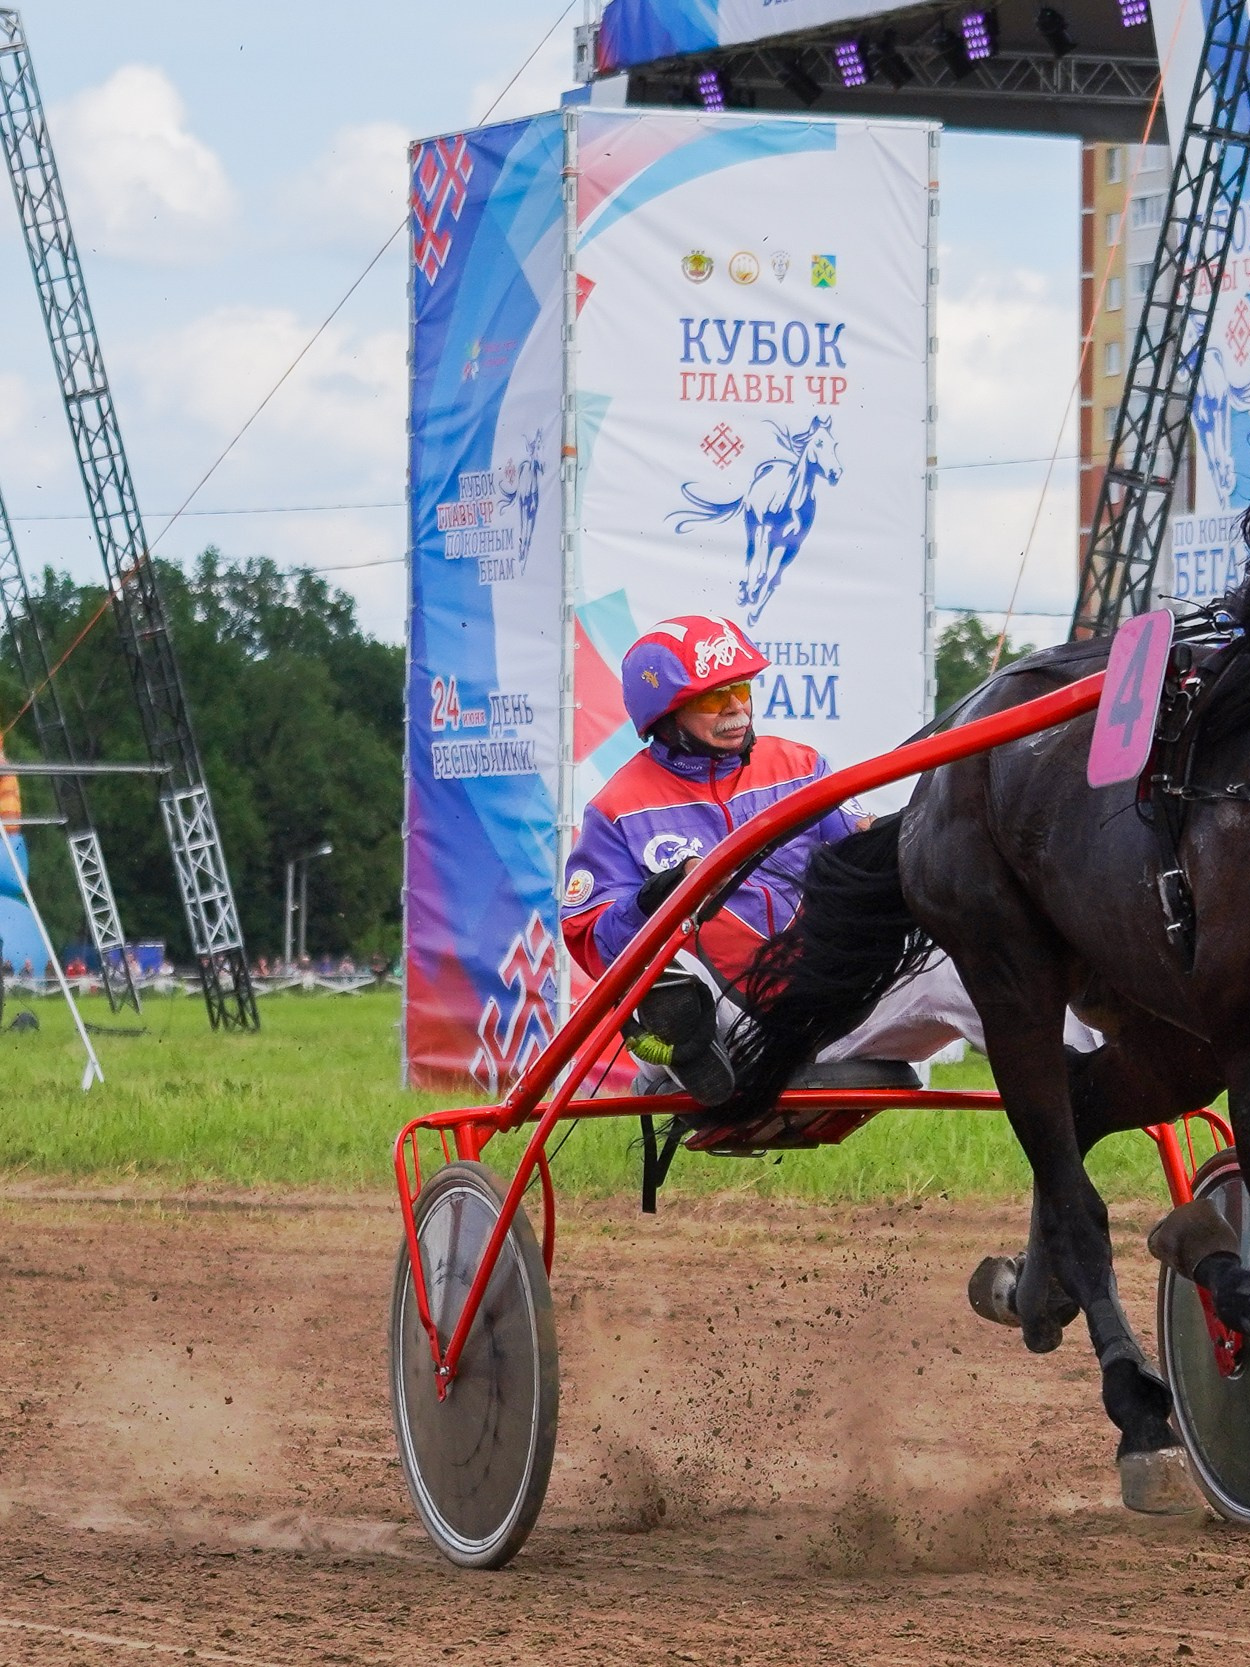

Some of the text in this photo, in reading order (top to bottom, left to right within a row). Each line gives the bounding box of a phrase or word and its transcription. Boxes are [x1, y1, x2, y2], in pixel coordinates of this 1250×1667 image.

[679, 318, 847, 368] КУБОК
[679, 372, 848, 405] ГЛАВЫ ЧР
[460, 474, 496, 499] КУБОК
[438, 502, 494, 530] ГЛАВЫ ЧР
[446, 529, 514, 558] ПО КОННЫМ
[1174, 522, 1194, 546] ПО
[479, 559, 516, 582] БЕГАМ
[1108, 620, 1154, 748] 4
[433, 680, 460, 728] 24
[490, 694, 534, 736] ДЕНЬ
[433, 740, 537, 776] РЕСПУБЛИКИ!
